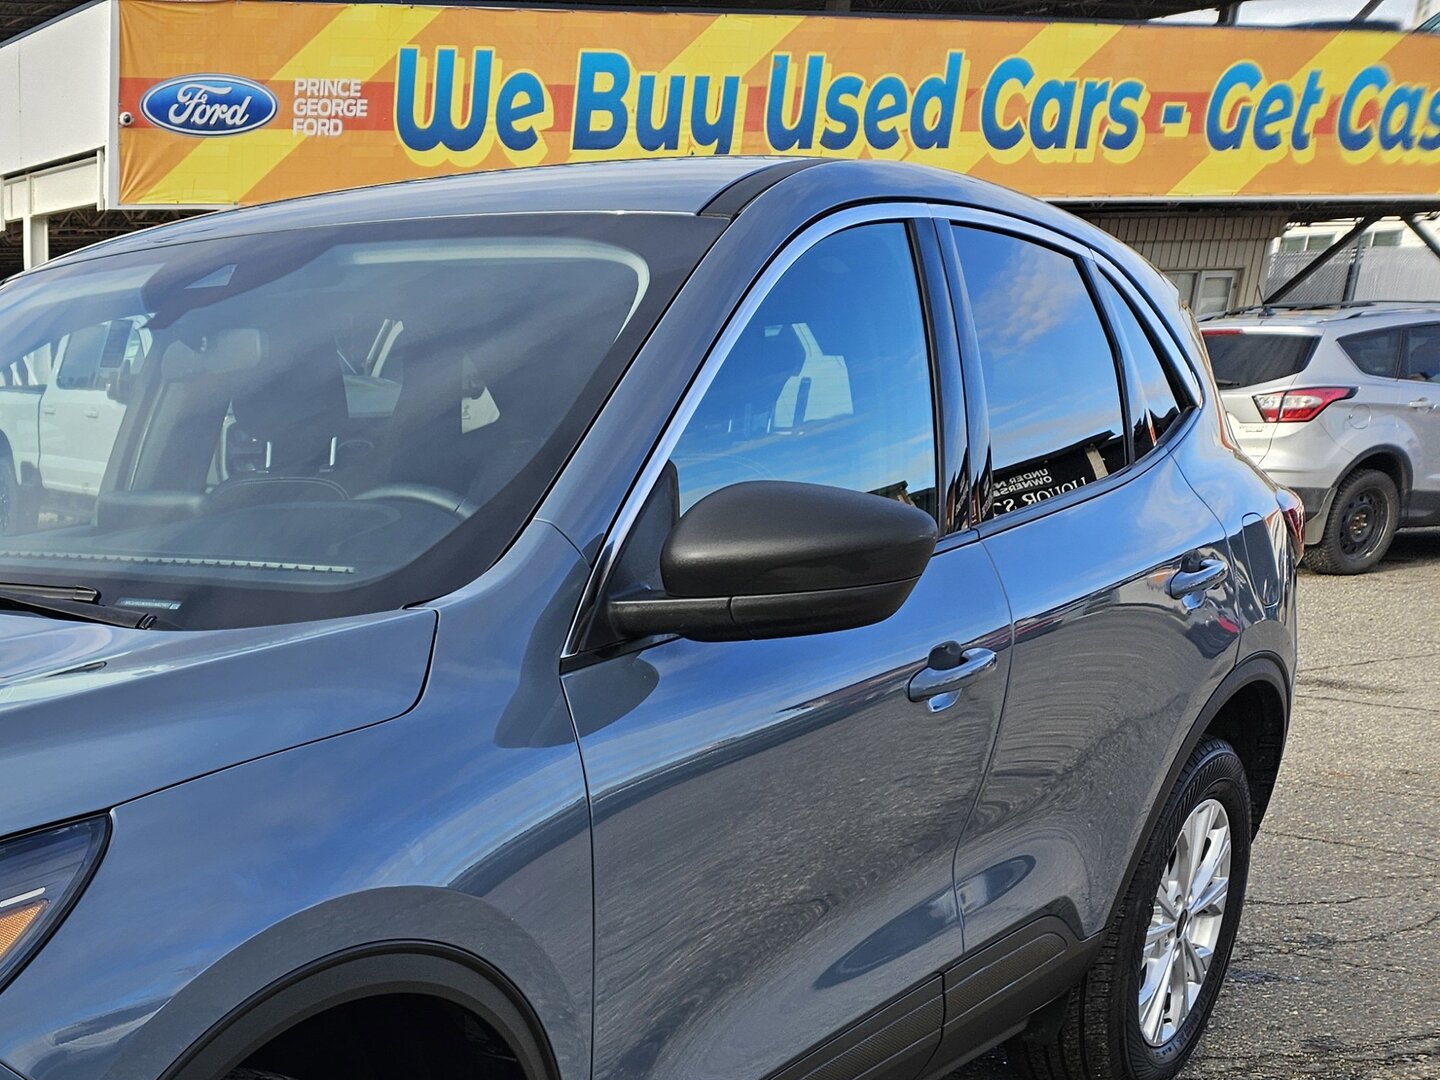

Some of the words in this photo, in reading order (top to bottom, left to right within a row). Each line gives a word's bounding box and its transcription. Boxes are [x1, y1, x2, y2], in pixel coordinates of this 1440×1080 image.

[293, 78, 362, 97] PRINCE
[167, 83, 253, 126] Ford
[292, 98, 368, 117] GEORGE
[394, 46, 545, 152] We
[571, 50, 742, 155] Buy
[765, 51, 964, 151] Used
[980, 56, 1146, 151] Cars
[1205, 61, 1326, 151] Get
[291, 118, 344, 137] FORD
